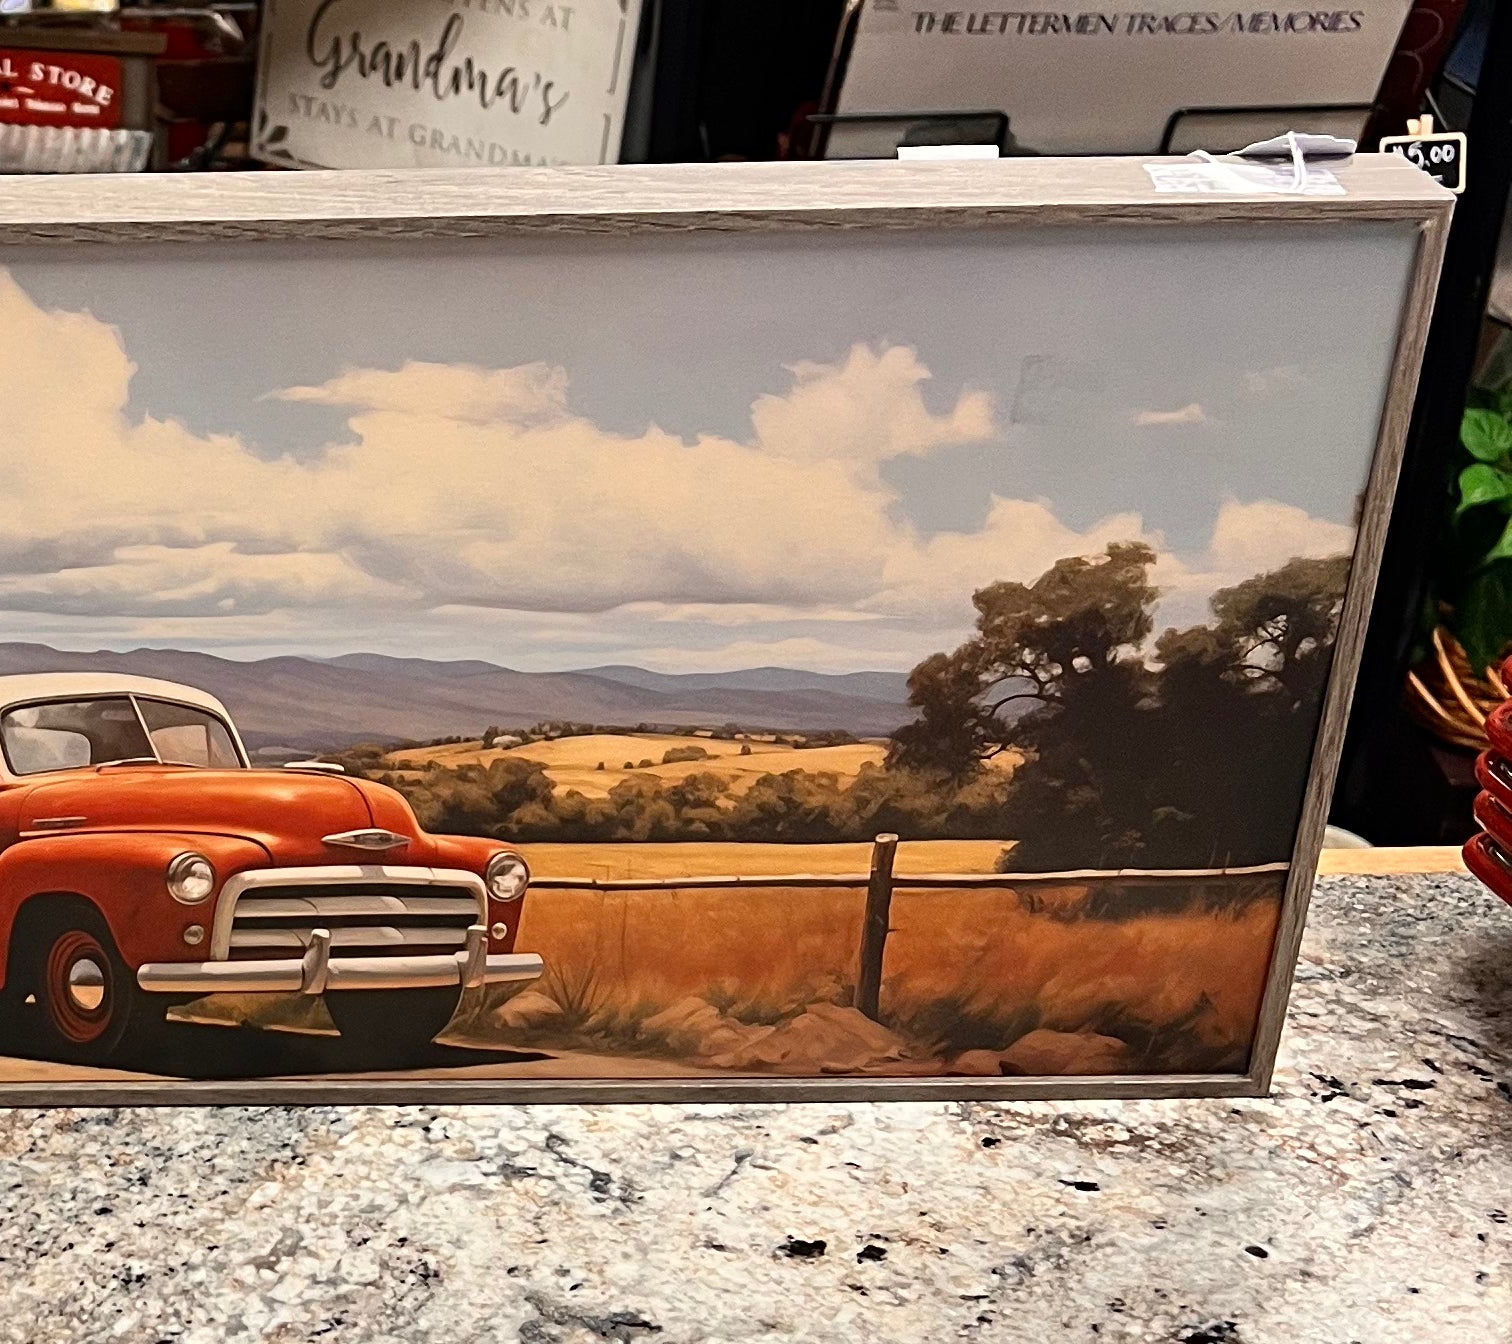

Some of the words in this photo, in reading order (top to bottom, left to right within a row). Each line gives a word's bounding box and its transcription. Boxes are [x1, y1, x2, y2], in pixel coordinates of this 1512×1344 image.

[540, 6, 577, 33] AT
[29, 61, 115, 107] STORE
[365, 114, 400, 140] AT
